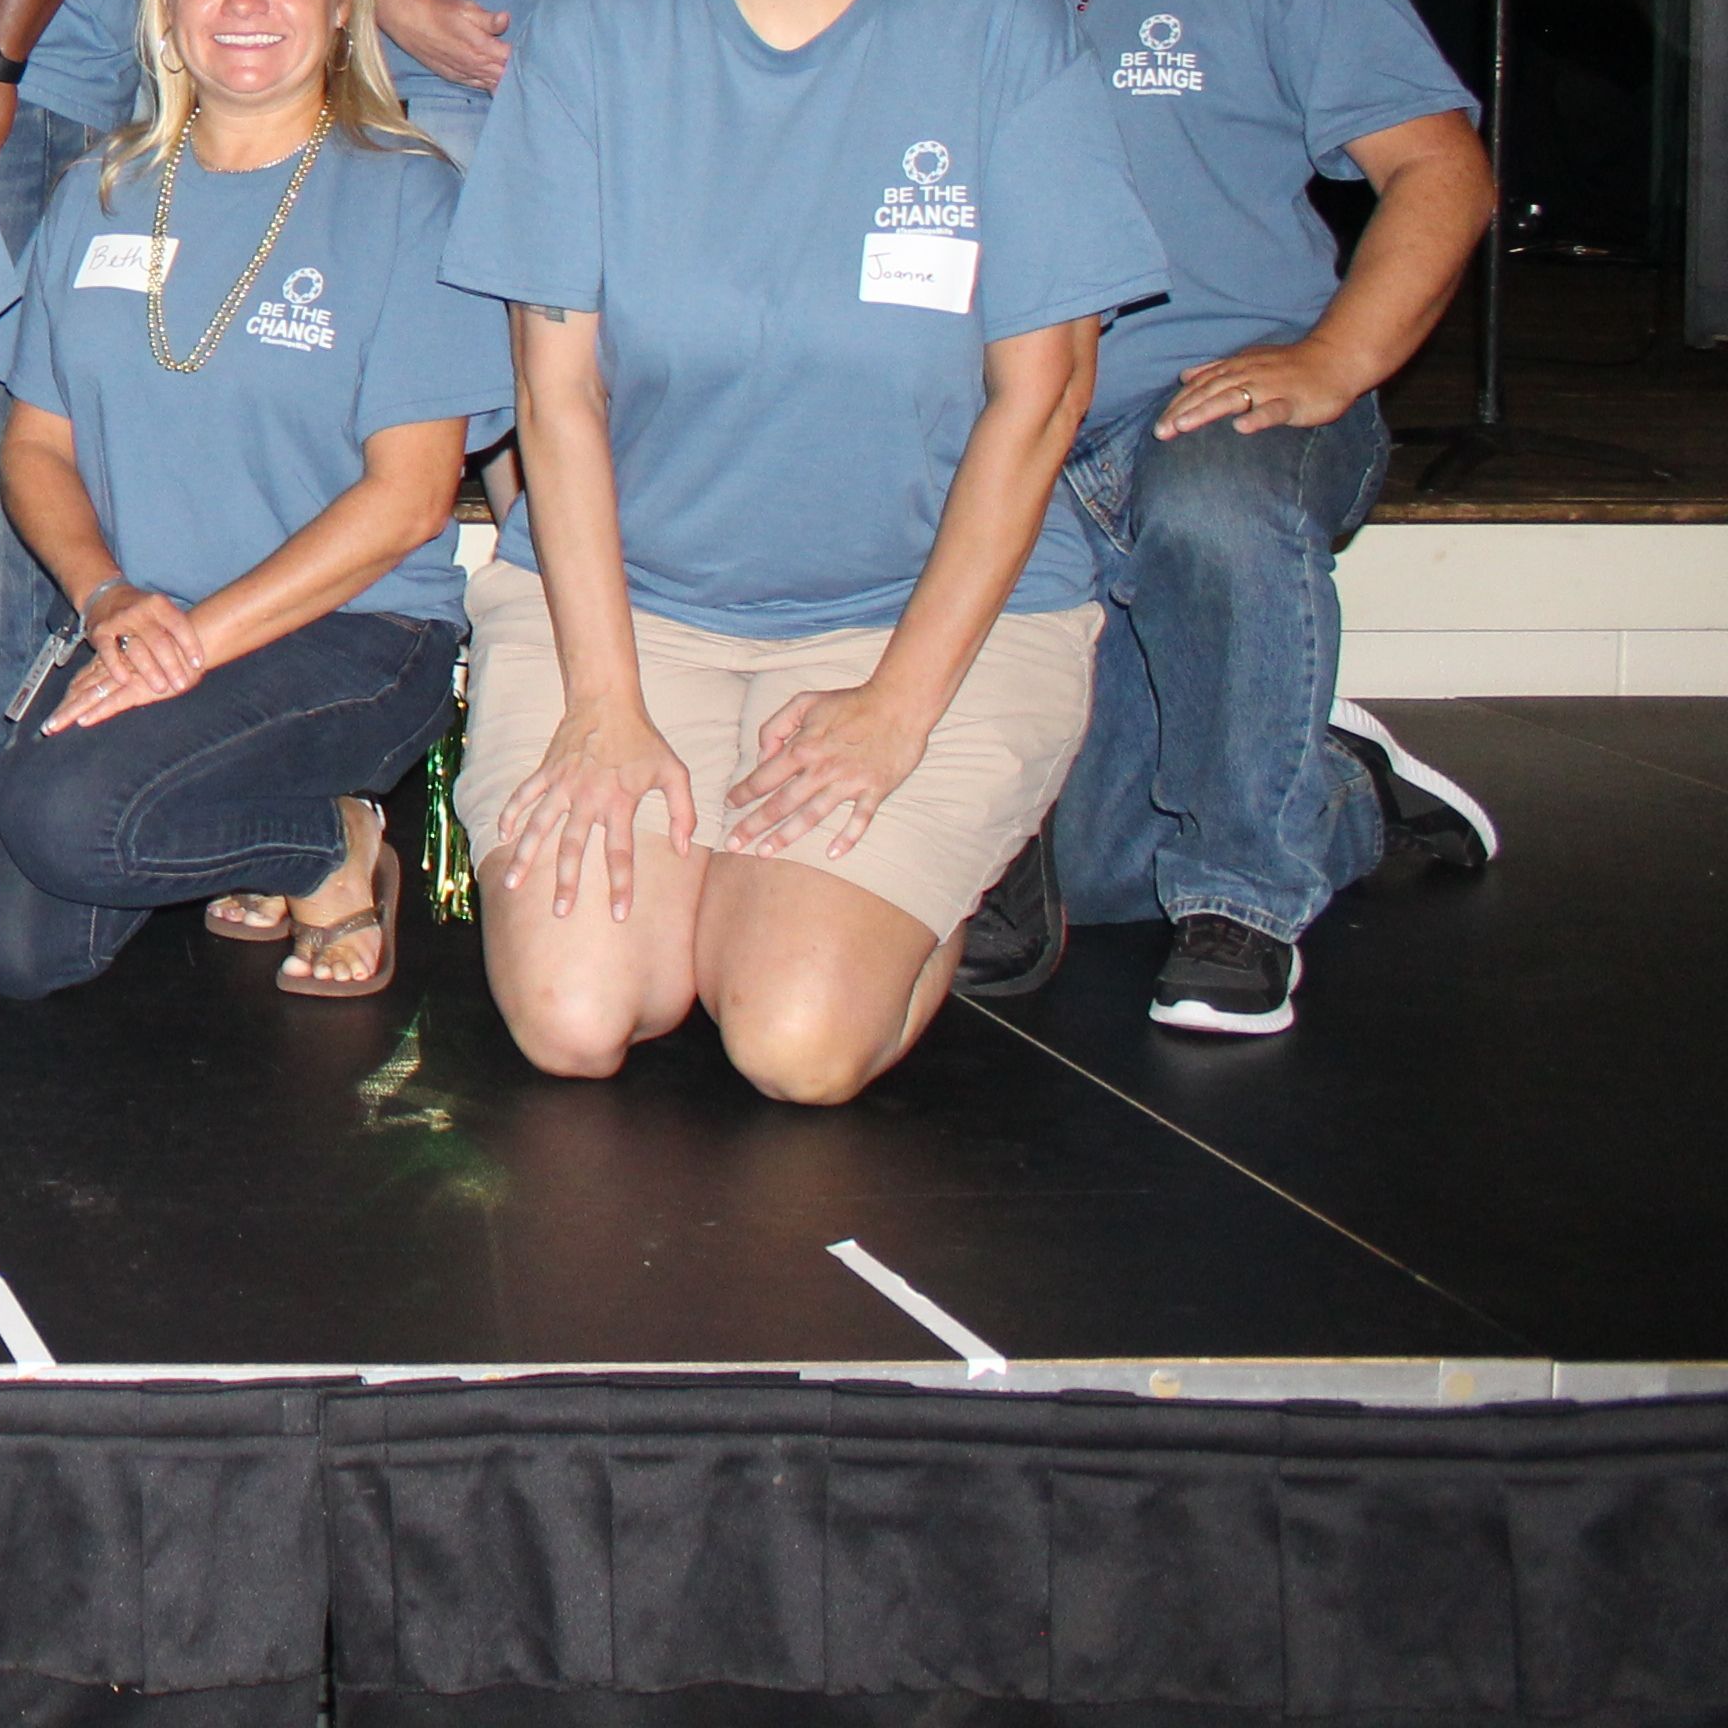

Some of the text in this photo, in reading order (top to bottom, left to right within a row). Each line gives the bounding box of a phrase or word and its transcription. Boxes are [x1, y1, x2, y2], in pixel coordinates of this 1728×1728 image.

[1120, 51, 1196, 69] BE THE
[1112, 67, 1203, 91] CHANGE
[884, 185, 968, 203] BE THE
[874, 205, 976, 228] CHANGE
[87, 244, 150, 271] Beth
[867, 252, 936, 283] Joanne
[258, 301, 332, 326] BE THE
[245, 316, 336, 349] CHANGE
